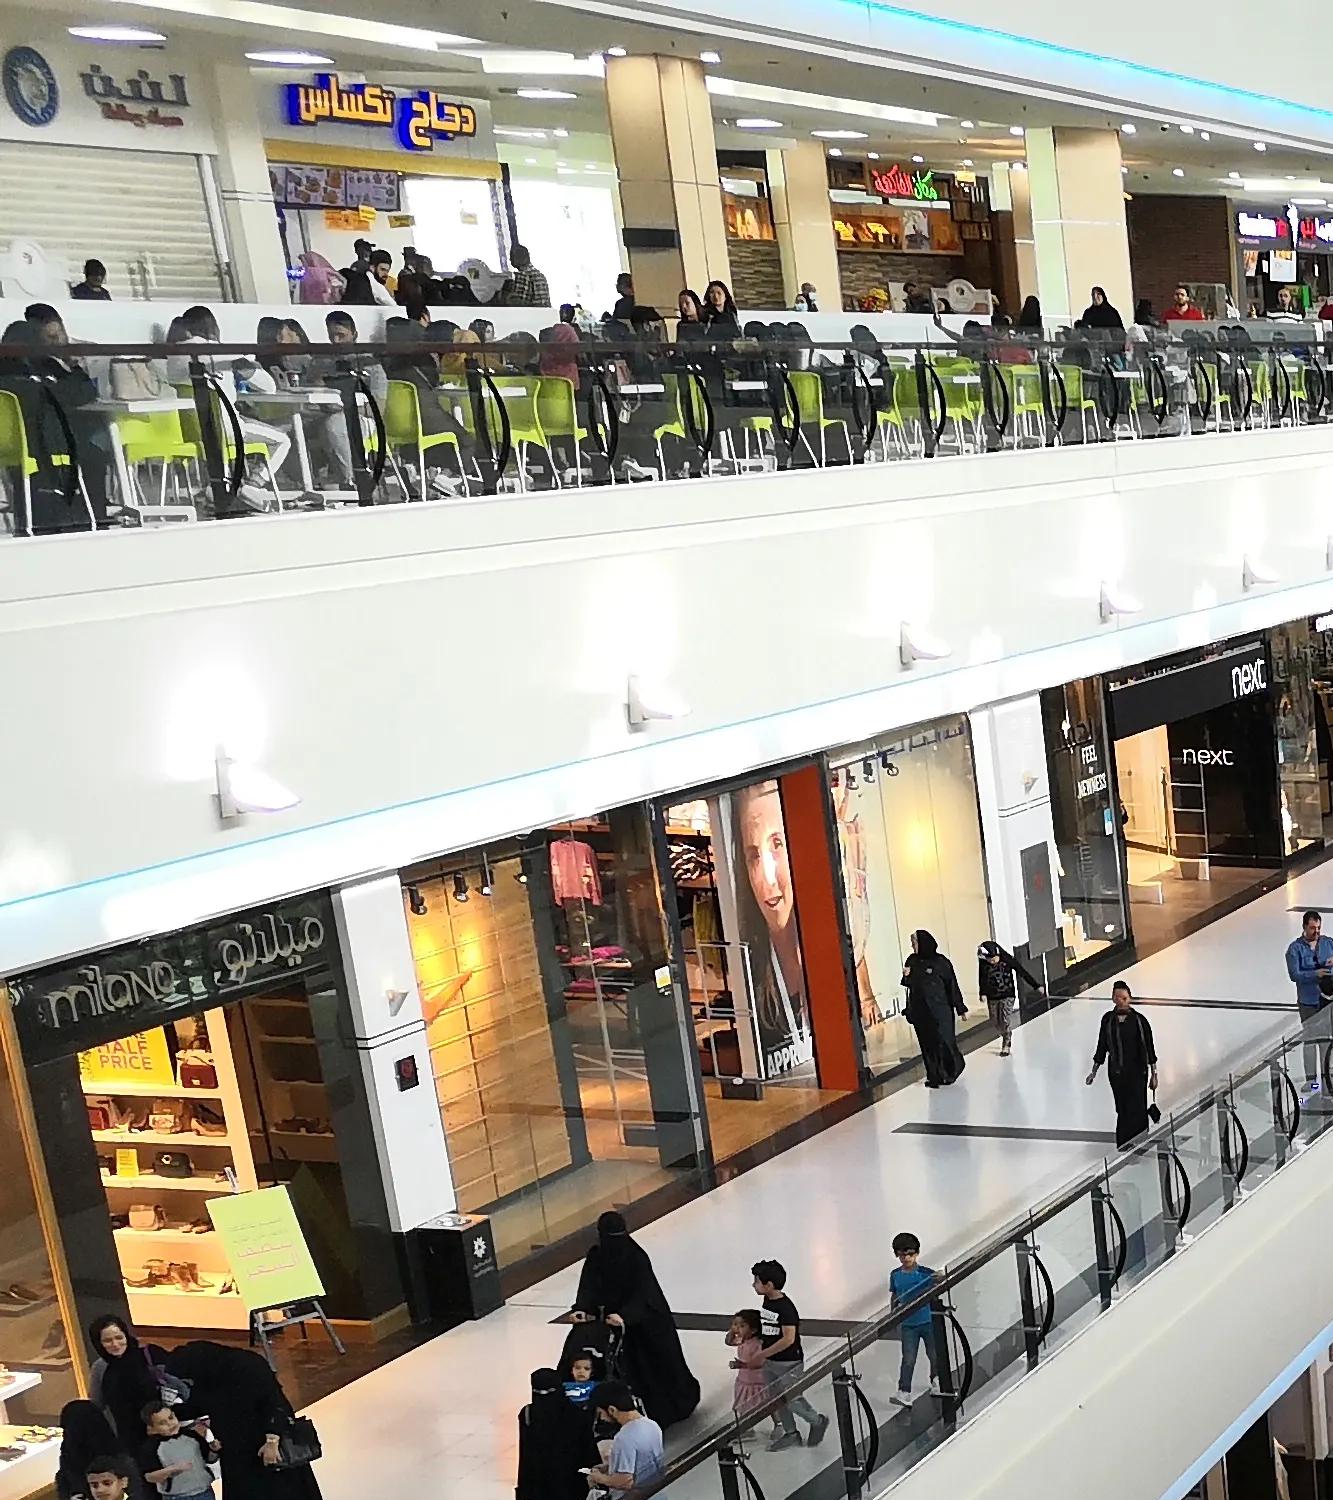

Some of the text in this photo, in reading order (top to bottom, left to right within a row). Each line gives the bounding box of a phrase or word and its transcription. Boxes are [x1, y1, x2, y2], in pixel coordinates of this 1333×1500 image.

[297, 74, 476, 149] دجاج تكساس
[1231, 658, 1267, 699] next
[1081, 744, 1097, 765] FEEL
[1182, 749, 1235, 766] next
[217, 913, 325, 986] ميلانو
[44, 961, 176, 1019] milano
[99, 1055, 153, 1071] PRICE
